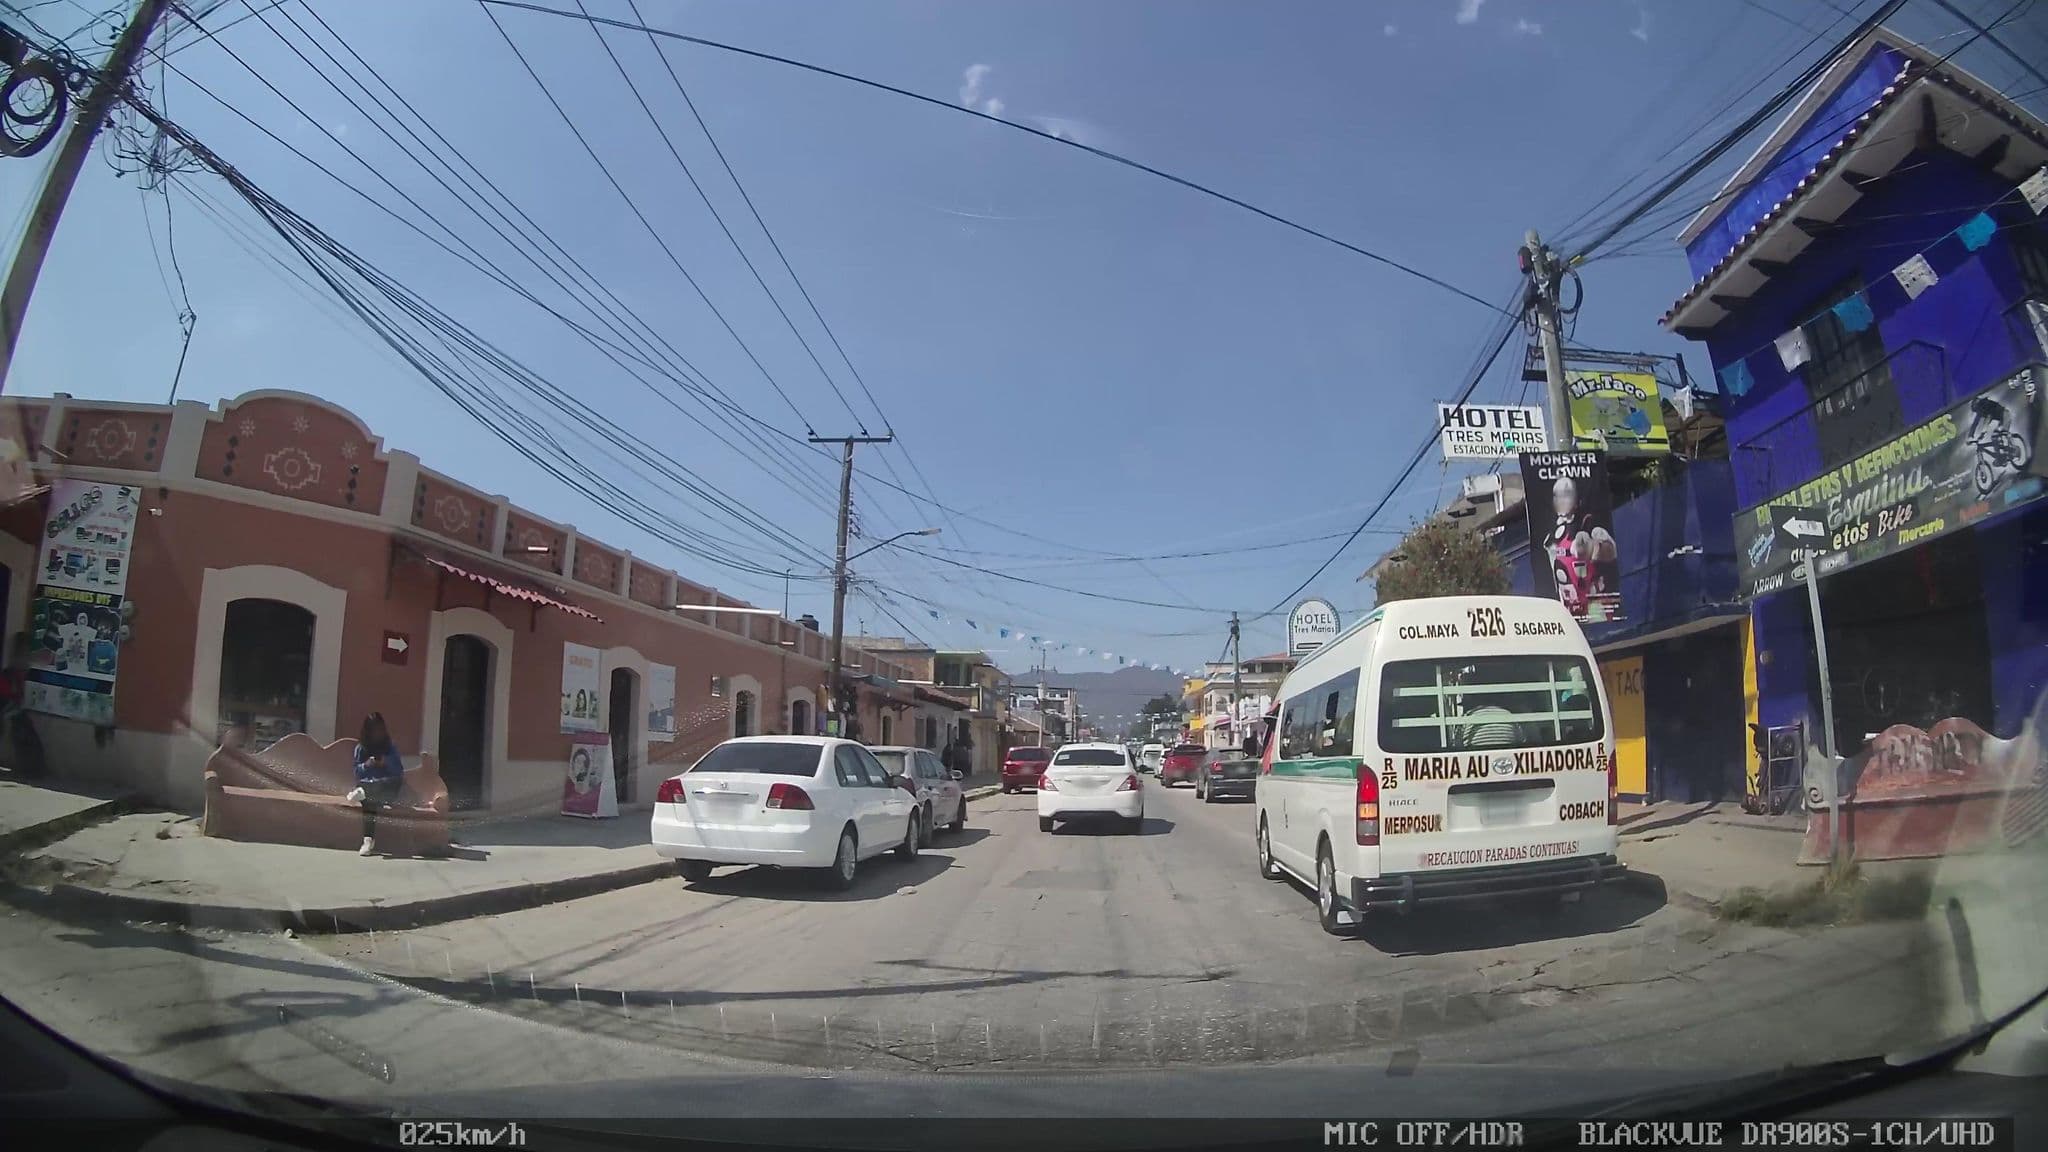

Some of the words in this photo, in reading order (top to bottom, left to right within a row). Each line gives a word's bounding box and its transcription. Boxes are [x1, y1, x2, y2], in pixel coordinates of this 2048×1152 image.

[1443, 408, 1542, 430] HOTEL
[1446, 430, 1484, 443] TRES
[1490, 431, 1544, 444] MARIAS
[1529, 453, 1597, 466] MONSTER
[1538, 466, 1591, 480] CLOWN
[1842, 464, 1852, 488] Y
[1827, 465, 1933, 530] Esquina
[1878, 503, 1913, 537] Bike
[1752, 572, 1784, 595] ARROW
[1296, 614, 1331, 624] HOTEL
[1467, 607, 1506, 637] 2526
[1514, 622, 1566, 636] SAGARPA
[1294, 625, 1309, 633] Tres
[1597, 743, 1605, 755] R
[1384, 758, 1394, 771] R
[1404, 756, 1461, 781] MARIA
[1466, 755, 1489, 778] AU
[1513, 747, 1595, 775] XILIADORA
[1596, 759, 1608, 772] 25
[1382, 776, 1398, 789] 25
[1559, 800, 1604, 821] COBACH
[1485, 846, 1527, 862] PARADAS
